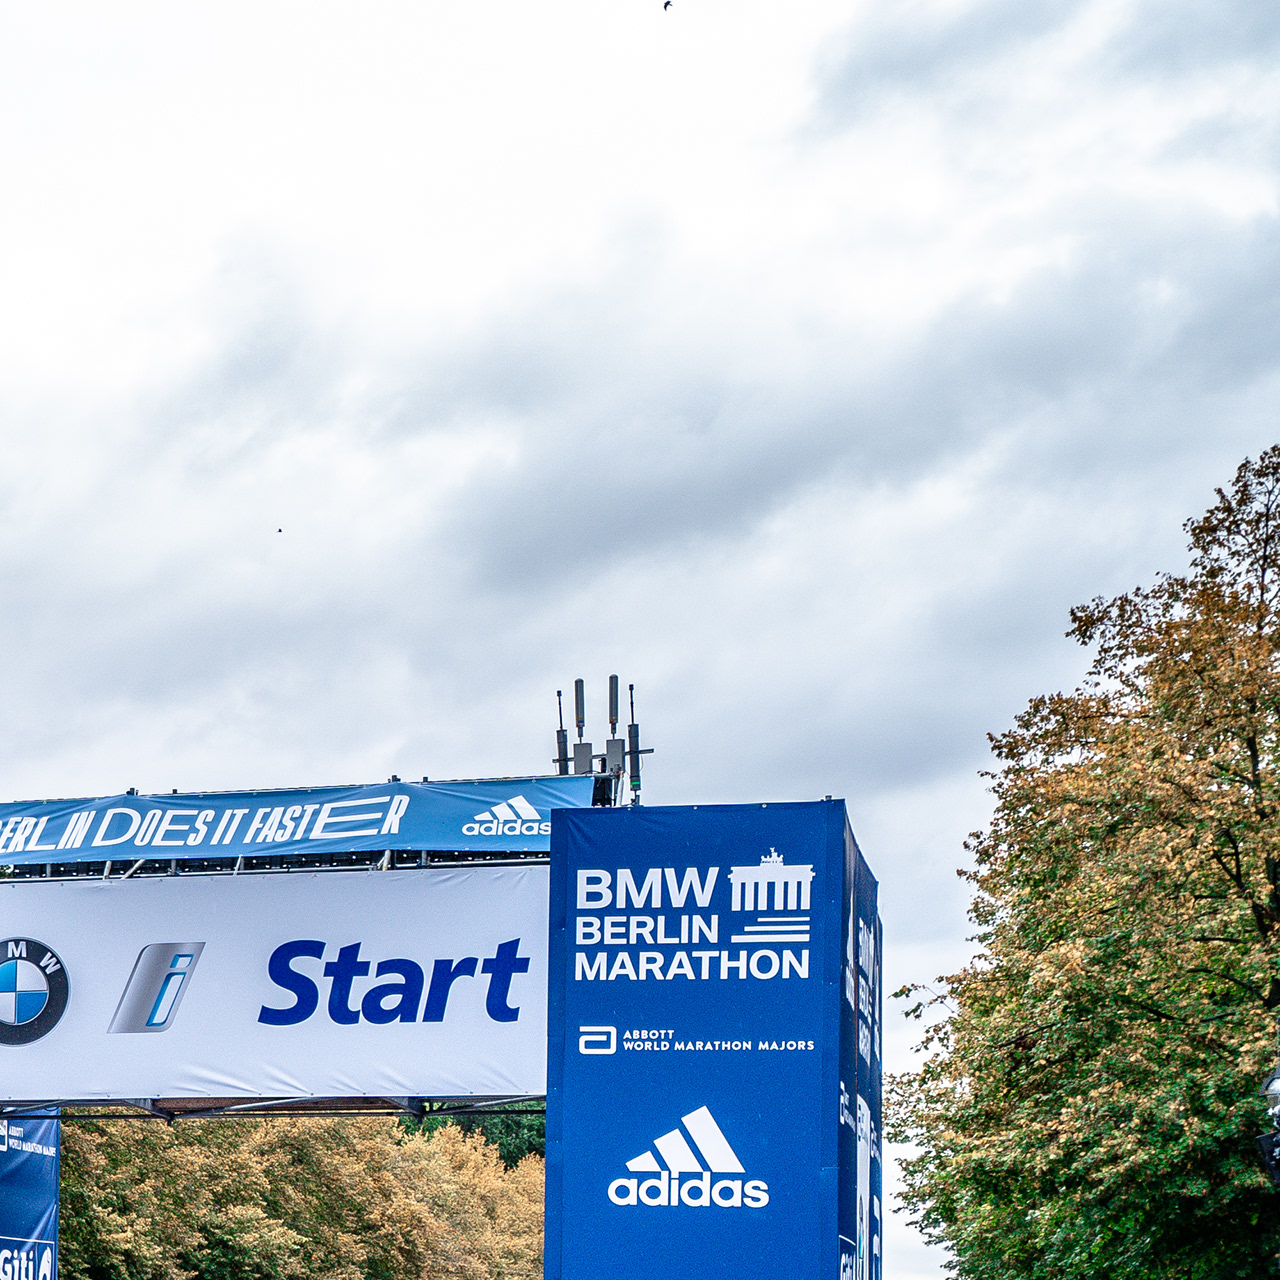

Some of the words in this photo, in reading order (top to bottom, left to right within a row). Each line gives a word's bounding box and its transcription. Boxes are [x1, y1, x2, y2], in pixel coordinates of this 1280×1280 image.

[91, 807, 215, 847] DOES
[210, 808, 250, 845] IT
[242, 795, 410, 844] FASTER
[462, 818, 551, 836] adidas
[577, 867, 719, 909] BMW
[576, 914, 718, 945] BERLIN
[575, 949, 809, 981] MARATHON
[257, 937, 531, 1027] Start
[623, 1029, 675, 1040] ABBOTT
[623, 1041, 670, 1051] WORLD
[674, 1040, 752, 1051] MARATHON
[758, 1040, 815, 1050] MAJORS
[608, 1170, 770, 1208] adidas
